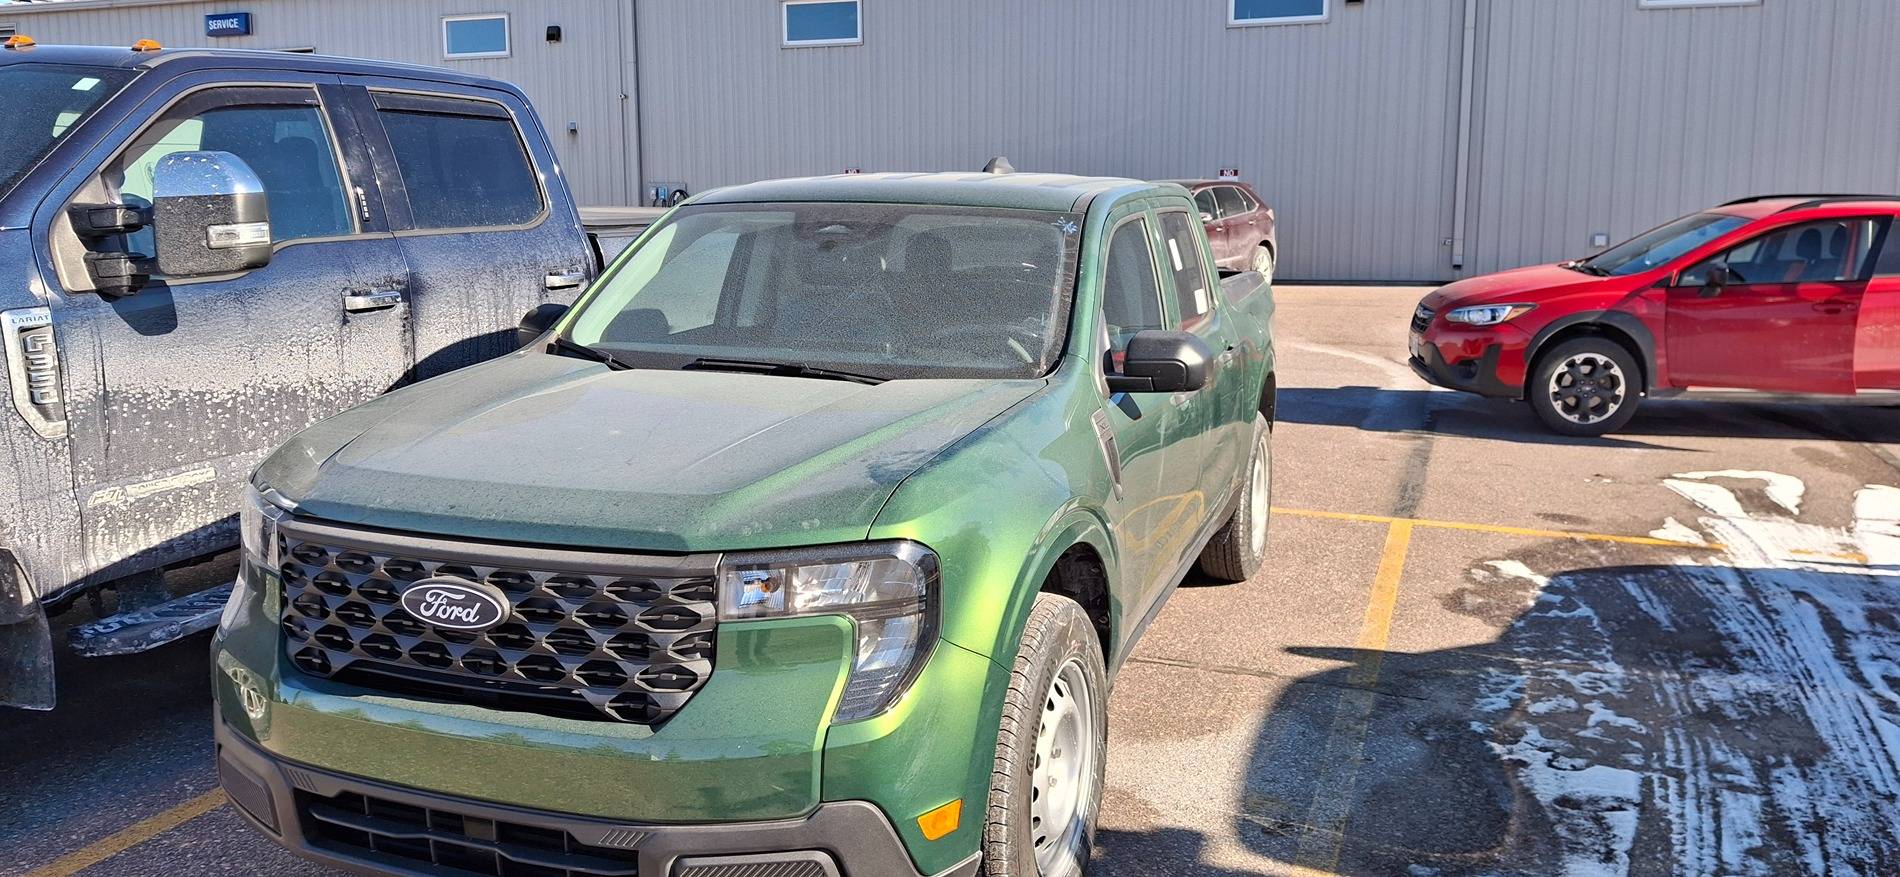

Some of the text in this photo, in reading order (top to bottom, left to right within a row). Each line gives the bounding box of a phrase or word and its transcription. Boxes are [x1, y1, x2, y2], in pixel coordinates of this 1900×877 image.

[208, 18, 239, 30] SERVICE
[1223, 169, 1235, 177] NO
[11, 315, 49, 324] LARIAT
[420, 589, 481, 623] Ford
